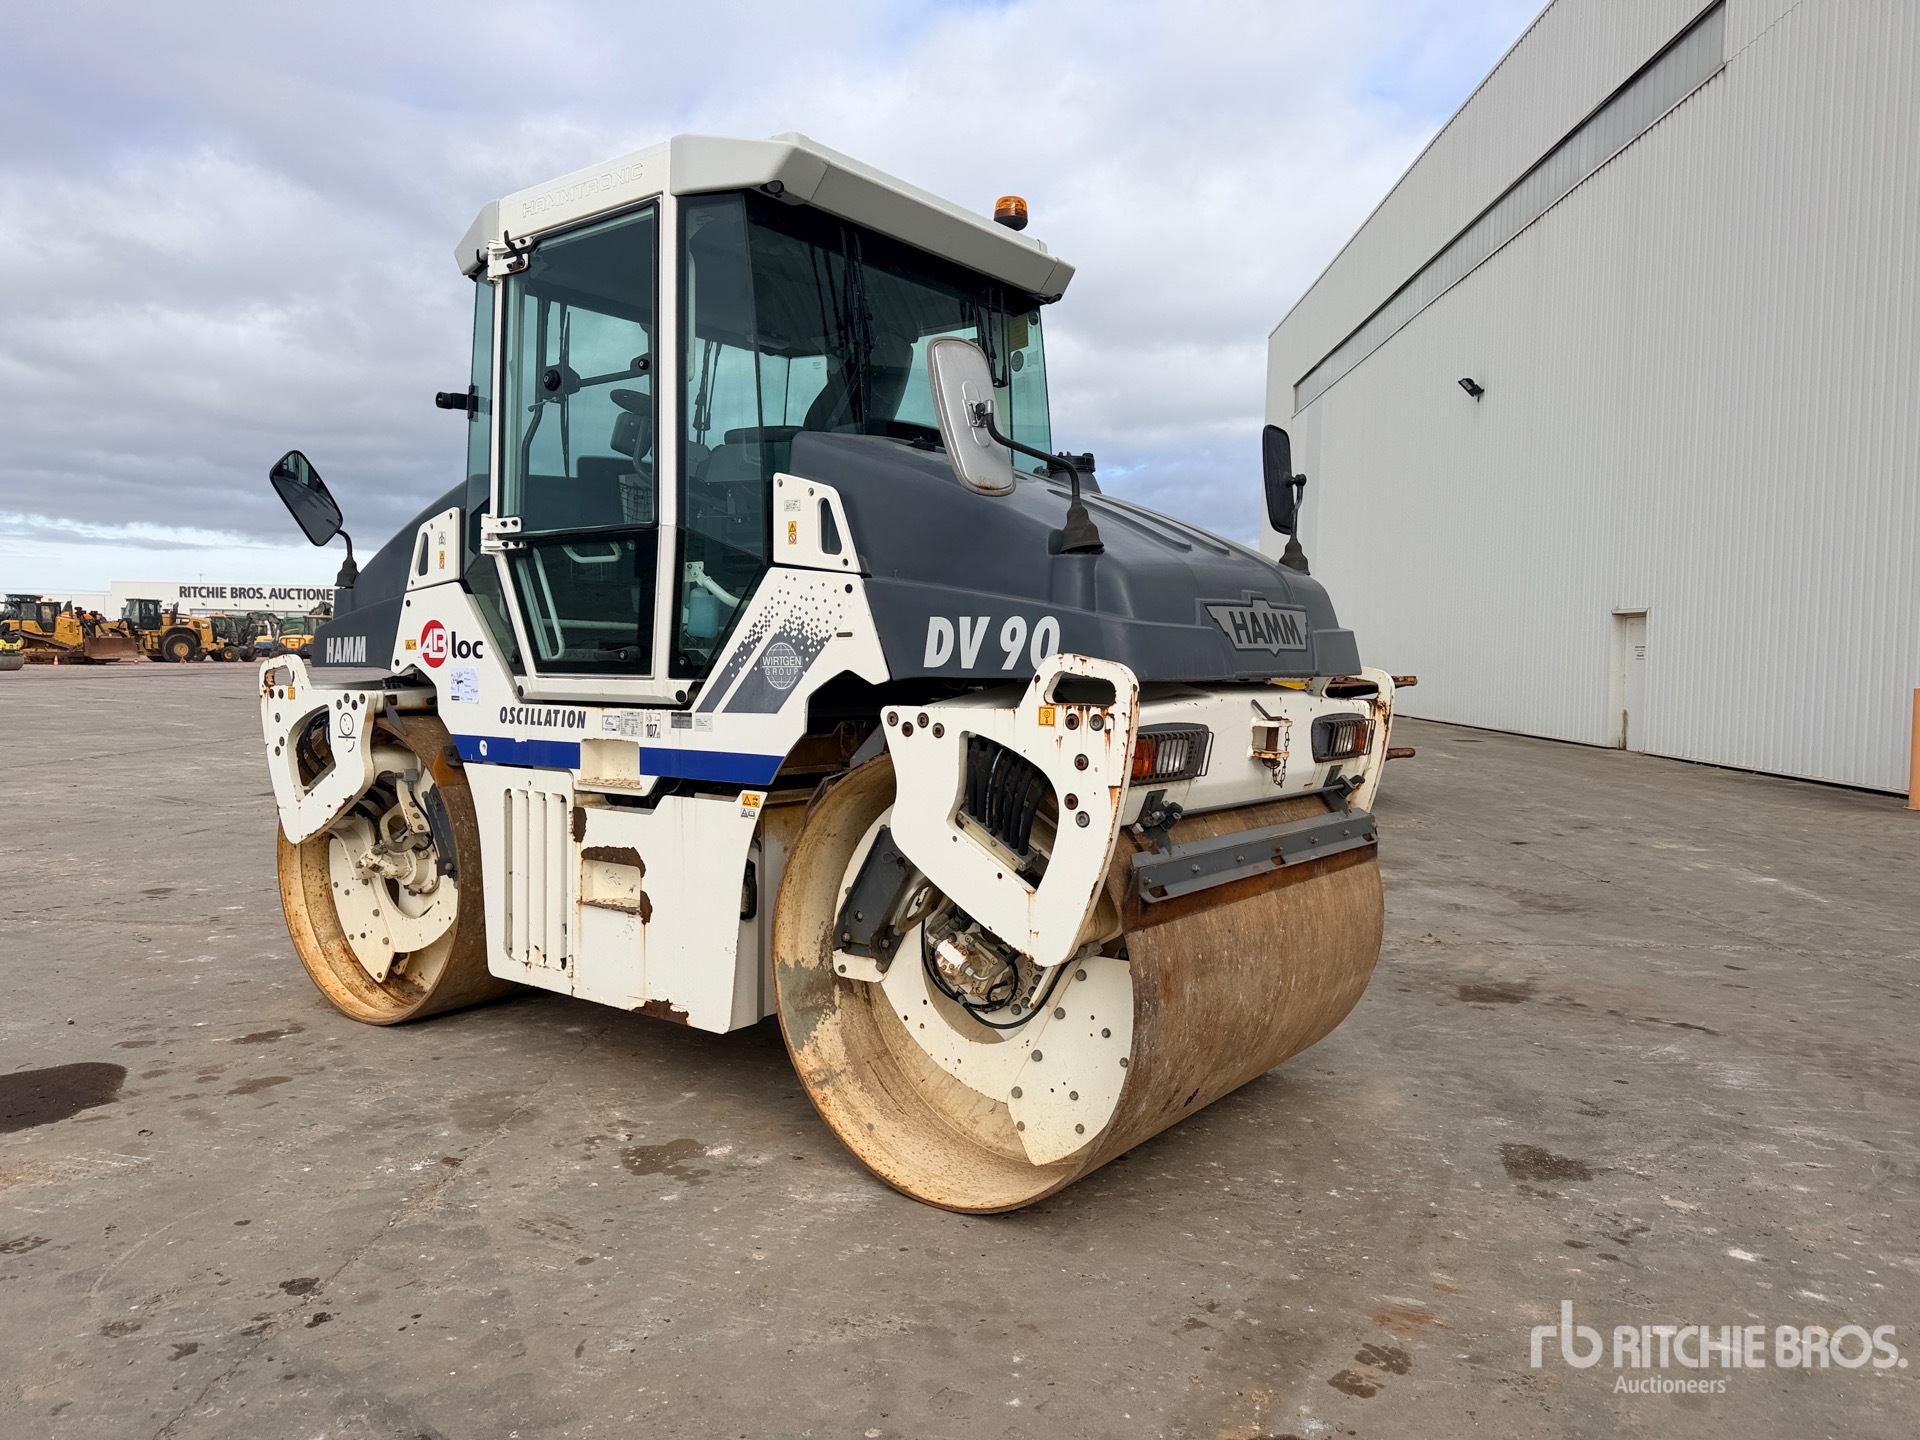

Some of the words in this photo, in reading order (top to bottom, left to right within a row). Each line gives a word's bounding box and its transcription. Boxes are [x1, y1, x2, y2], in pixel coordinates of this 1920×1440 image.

[522, 162, 644, 218] HAMMTRONIC
[179, 586, 227, 598] RITCHIE
[230, 587, 266, 599] BROS.
[1228, 610, 1304, 646] HAMM
[325, 636, 367, 664] HAMM
[923, 616, 992, 669] DV
[999, 615, 1061, 671] 90
[762, 656, 802, 667] WIRTGEN
[765, 667, 799, 676] GROUP
[499, 706, 587, 729] OSCILLATION
